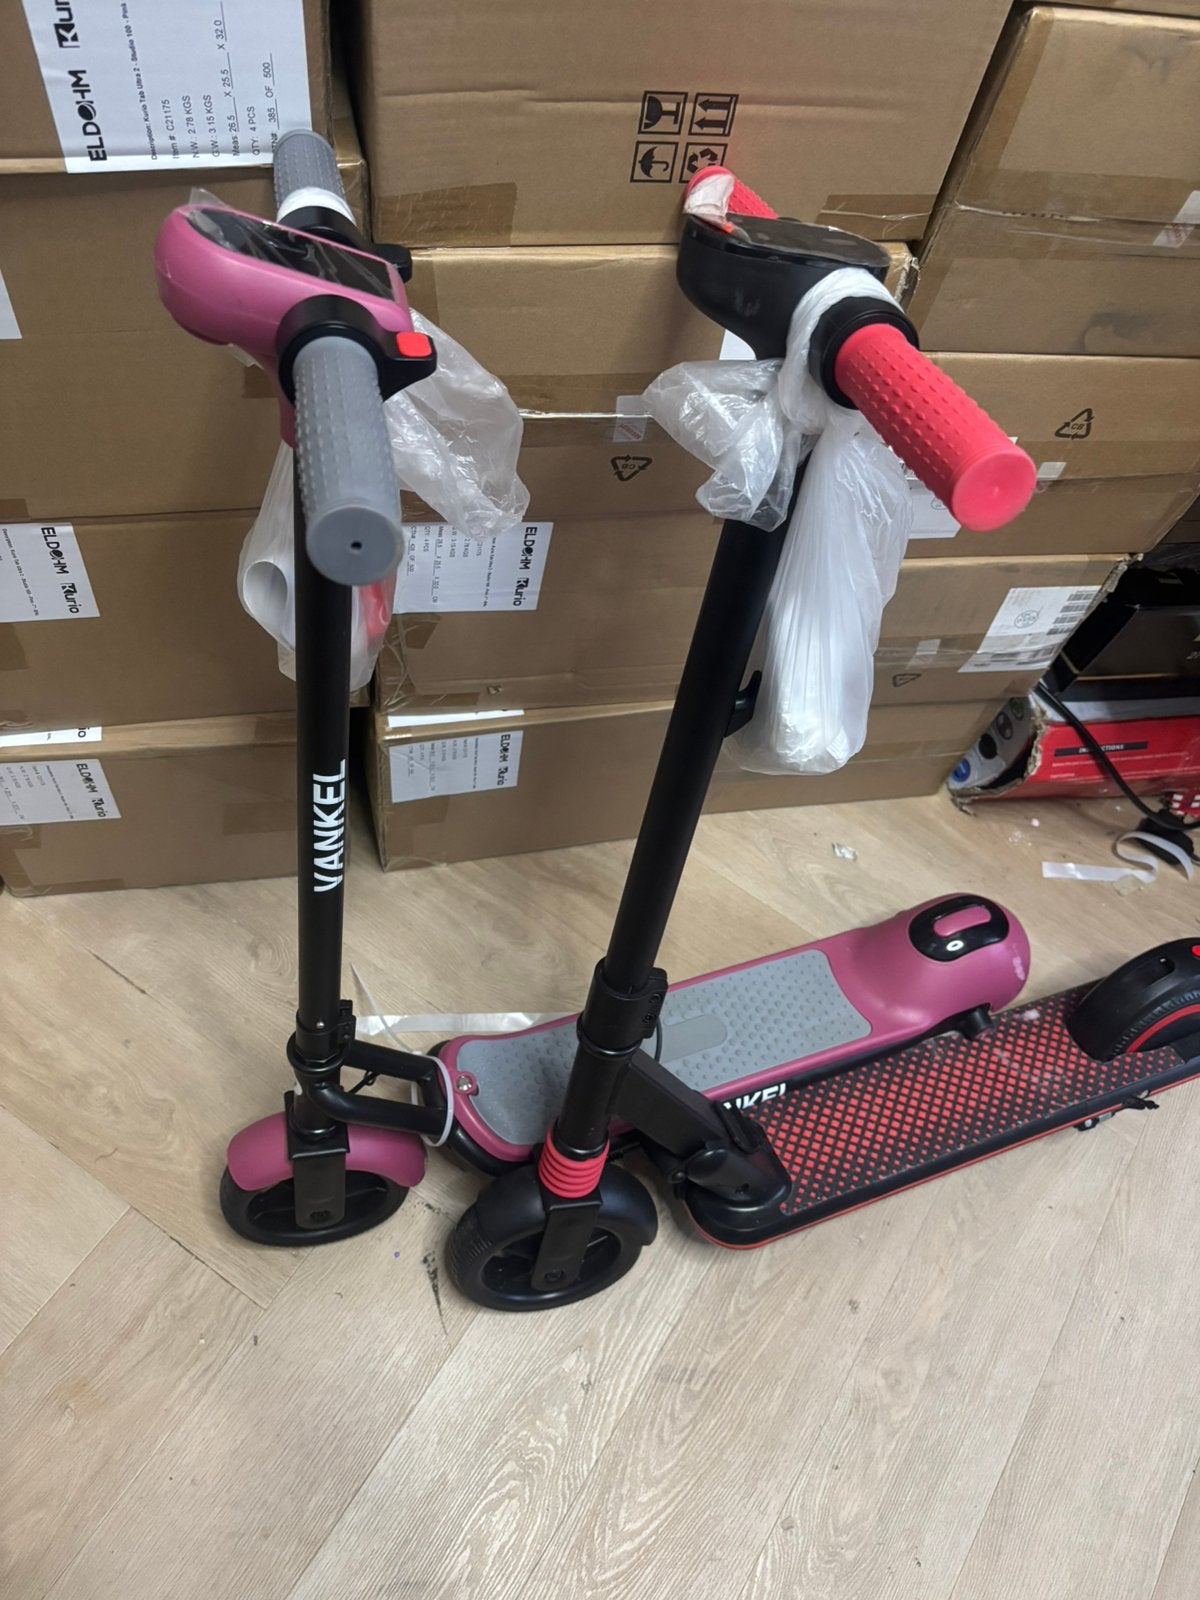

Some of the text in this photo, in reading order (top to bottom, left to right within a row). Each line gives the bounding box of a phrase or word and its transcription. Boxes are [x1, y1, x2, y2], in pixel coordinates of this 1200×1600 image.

[129, 39, 137, 61] Studio
[262, 62, 271, 78] 500
[265, 85, 274, 98] OF
[141, 104, 149, 122] Kurio
[182, 95, 192, 115] KGS
[203, 95, 213, 114] KGS
[68, 70, 108, 161] ELDOHM
[162, 99, 174, 131] C21175
[247, 106, 256, 125] PCS
[267, 107, 276, 123] 385
[41, 526, 83, 614] ELDOHM Kurio
[513, 526, 538, 607] ELDOHM Kurio
[312, 759, 346, 892] VANKEL
